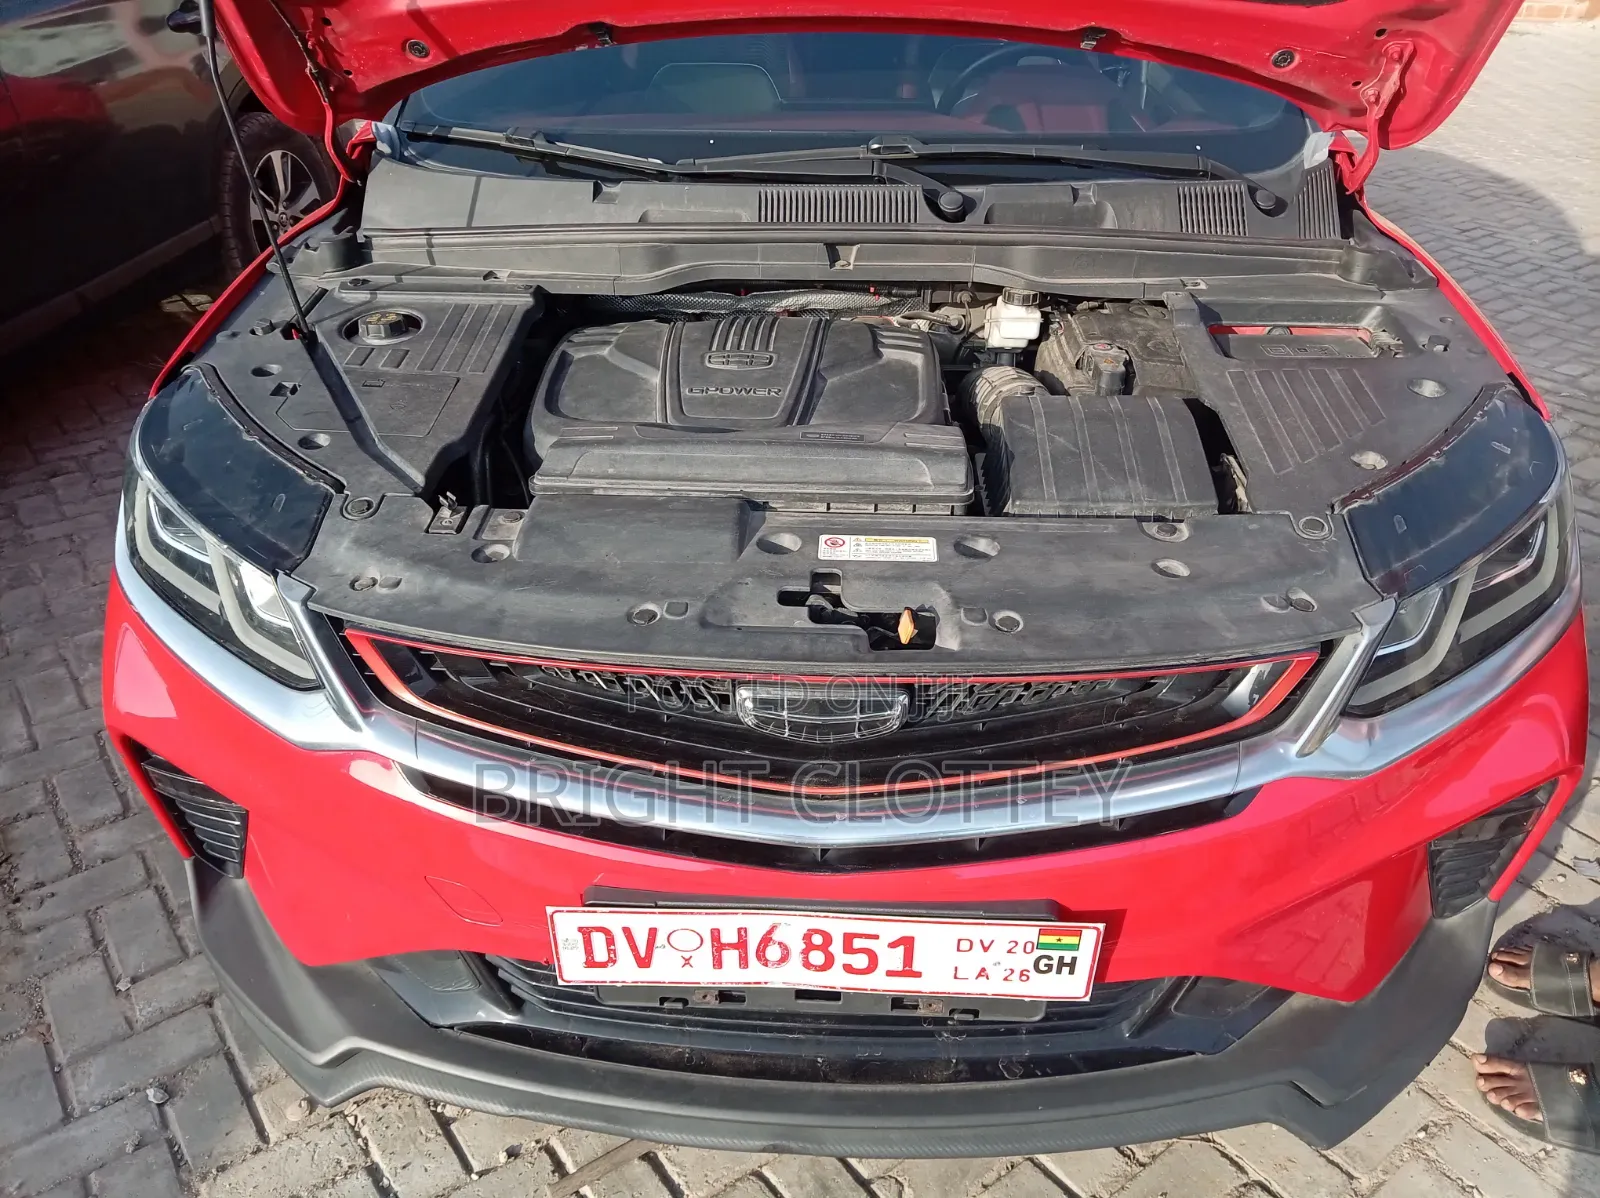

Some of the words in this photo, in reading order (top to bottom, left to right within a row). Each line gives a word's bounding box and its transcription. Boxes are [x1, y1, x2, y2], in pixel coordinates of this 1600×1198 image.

[687, 386, 782, 397] GPOWER
[577, 926, 658, 969] DV
[710, 923, 923, 977] H6851
[956, 938, 995, 954] DV
[1006, 940, 1036, 955] 20
[1033, 954, 1078, 976] GH
[953, 966, 990, 980] LA
[1002, 968, 1032, 982] 26
